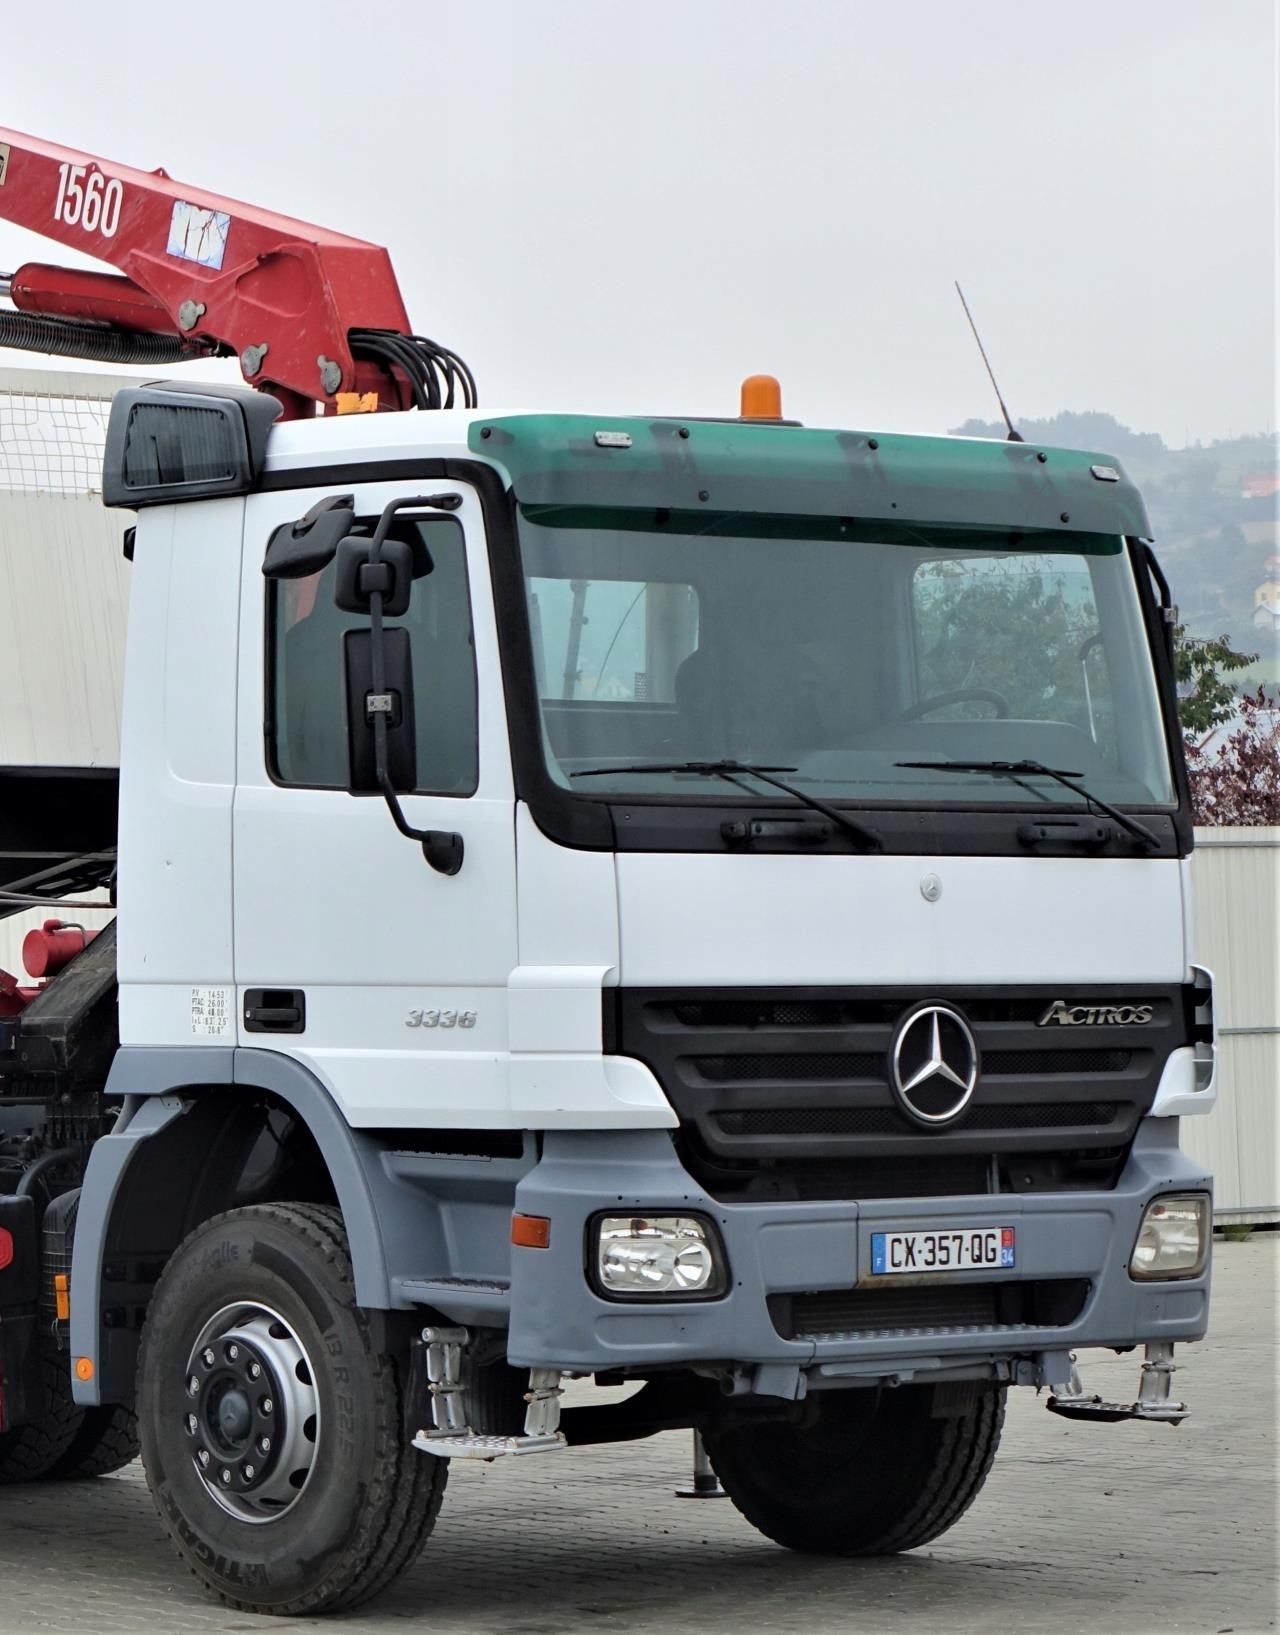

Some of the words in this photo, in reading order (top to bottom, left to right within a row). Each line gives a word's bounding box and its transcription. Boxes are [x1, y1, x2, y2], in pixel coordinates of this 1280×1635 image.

[54, 163, 123, 238] 1560
[405, 1008, 478, 1028] 3336
[1001, 1248, 1014, 1264] 34
